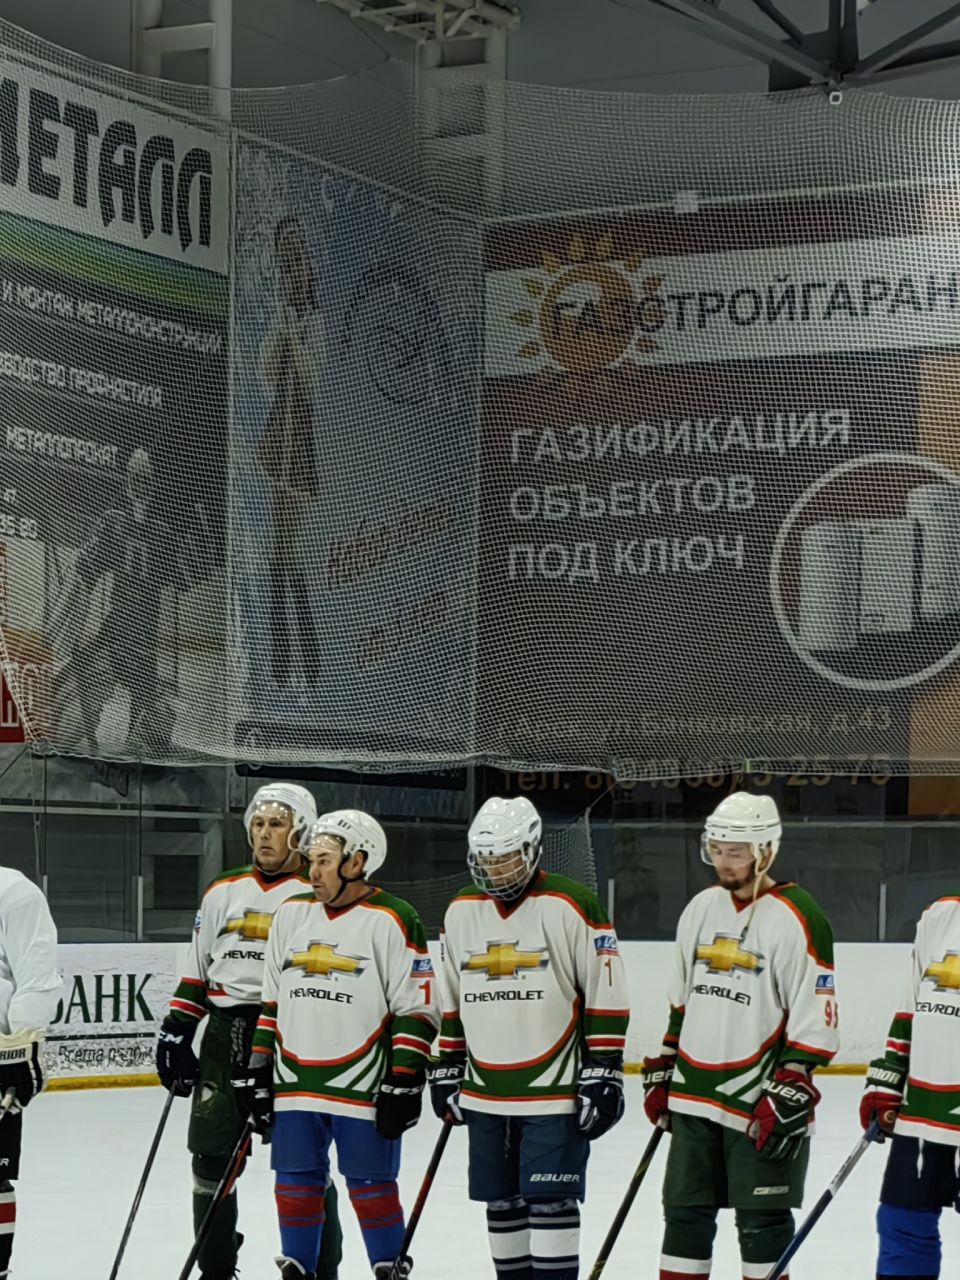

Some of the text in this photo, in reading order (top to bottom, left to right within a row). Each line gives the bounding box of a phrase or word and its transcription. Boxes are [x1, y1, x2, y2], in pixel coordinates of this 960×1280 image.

[510, 408, 851, 465] ГАЗИФИКАЦИЯ
[509, 474, 758, 523] ОБЪЕКТОВ
[507, 534, 746, 586] ПОД КЛЮЧ
[418, 980, 431, 1005] 1
[464, 990, 544, 1003] CHEVROLET
[692, 984, 751, 1006] HEVROLET
[425, 1067, 460, 1081] UER
[580, 1067, 623, 1079] BAUE
[642, 1072, 673, 1085] UER
[529, 1172, 580, 1184] BAUER
